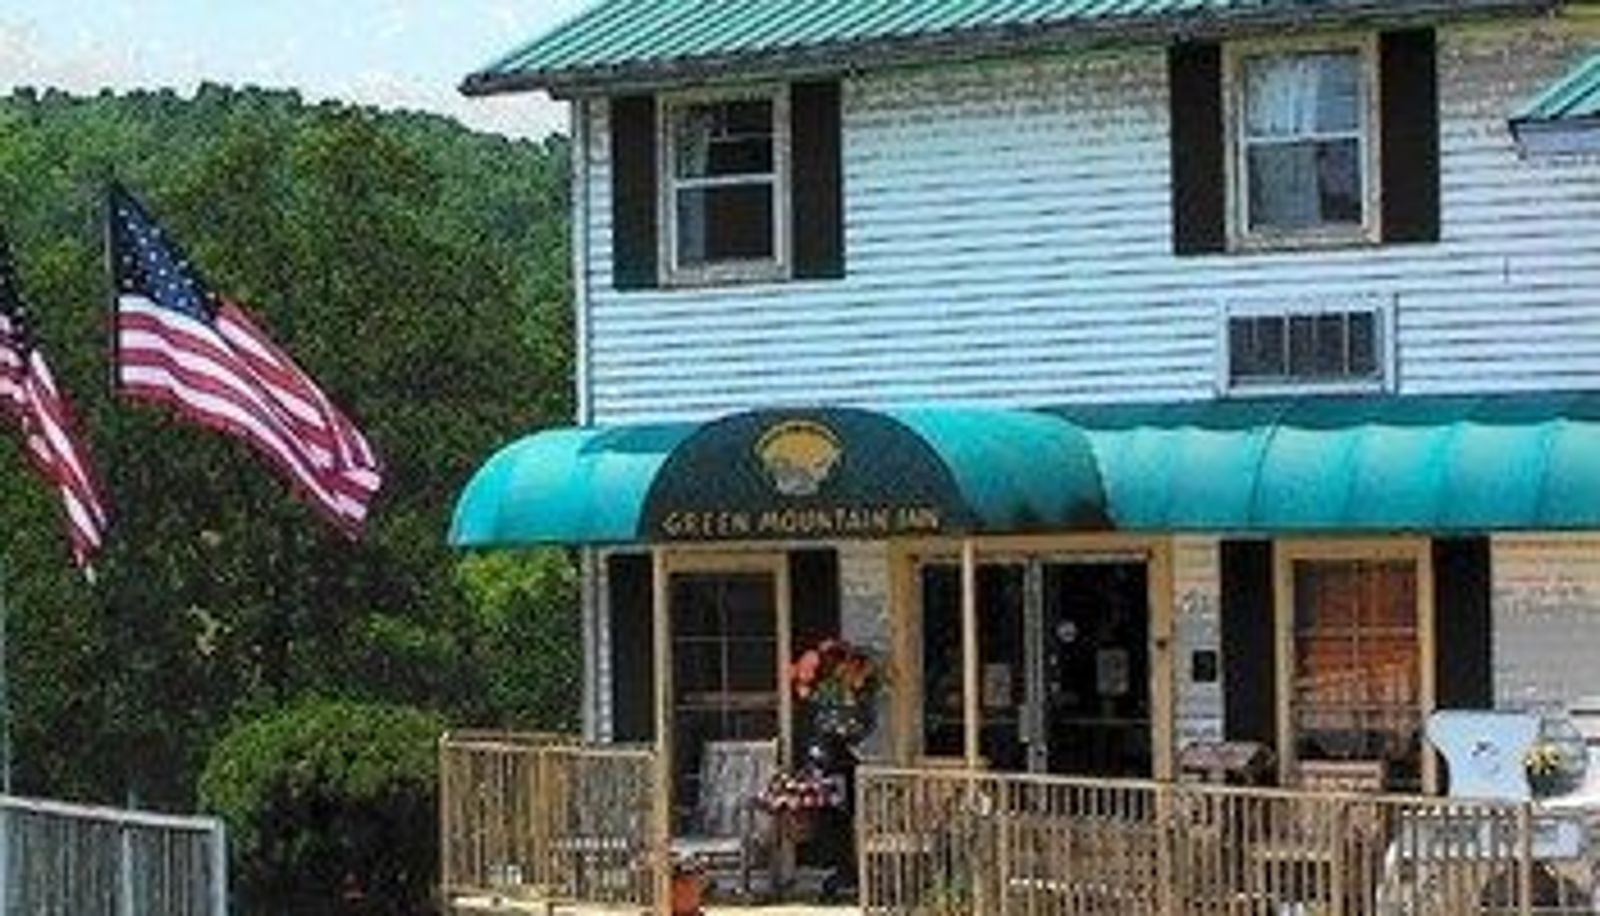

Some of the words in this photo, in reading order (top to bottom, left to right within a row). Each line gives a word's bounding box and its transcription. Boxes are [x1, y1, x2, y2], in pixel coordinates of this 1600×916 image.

[661, 511, 750, 535] GREEN
[757, 507, 889, 532] MOUNTAIN
[899, 507, 939, 529] INN
